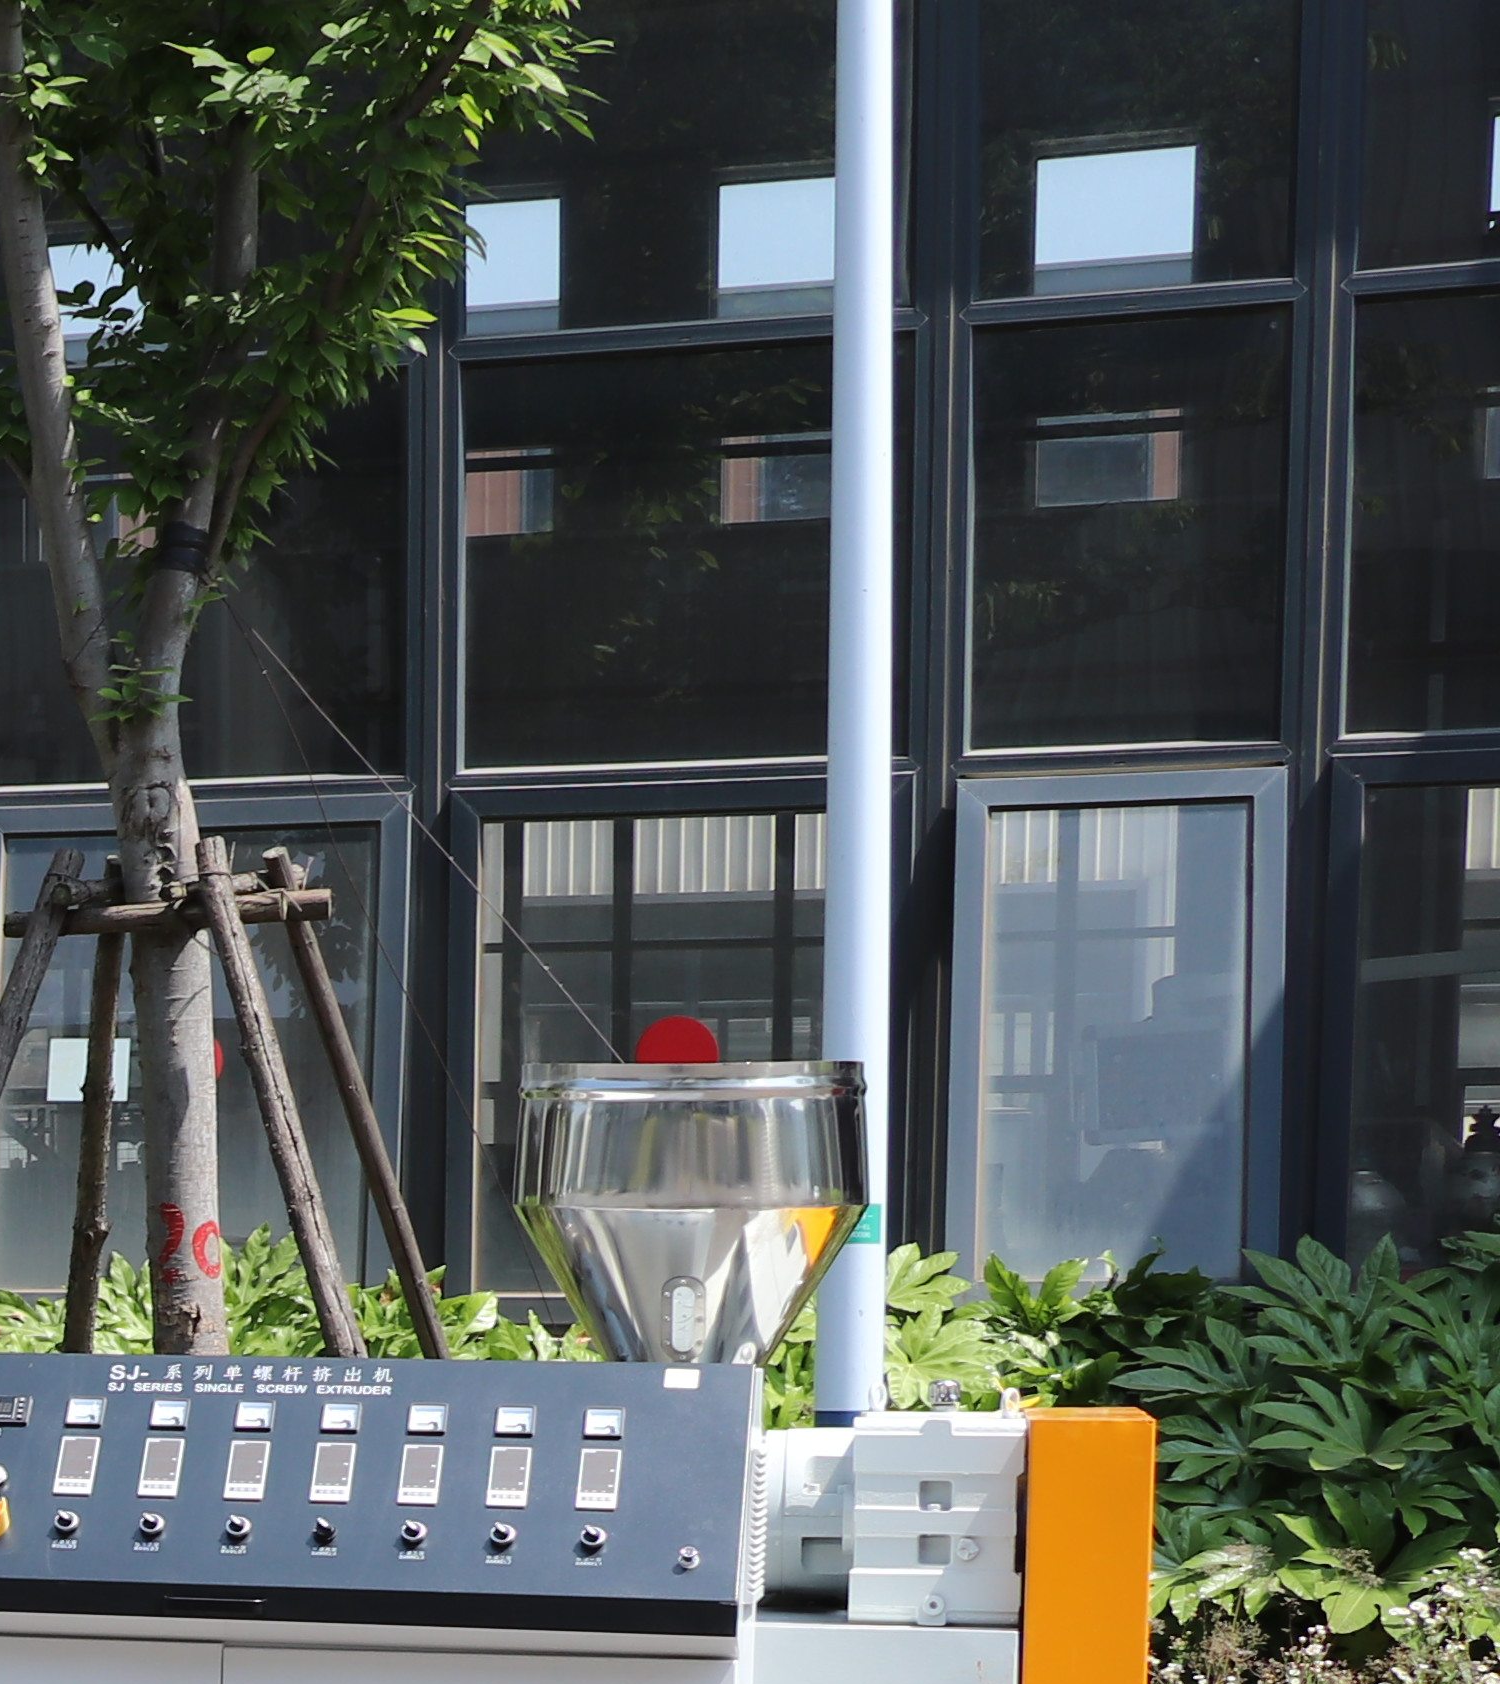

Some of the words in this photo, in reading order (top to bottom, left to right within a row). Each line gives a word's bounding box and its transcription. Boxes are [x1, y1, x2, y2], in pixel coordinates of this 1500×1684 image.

[107, 1382, 125, 1392] SJ
[133, 1382, 183, 1392] SERIES
[194, 1383, 245, 1393] SINGLE
[256, 1384, 308, 1394] SCREW
[316, 1385, 392, 1395] EXTRUDER
